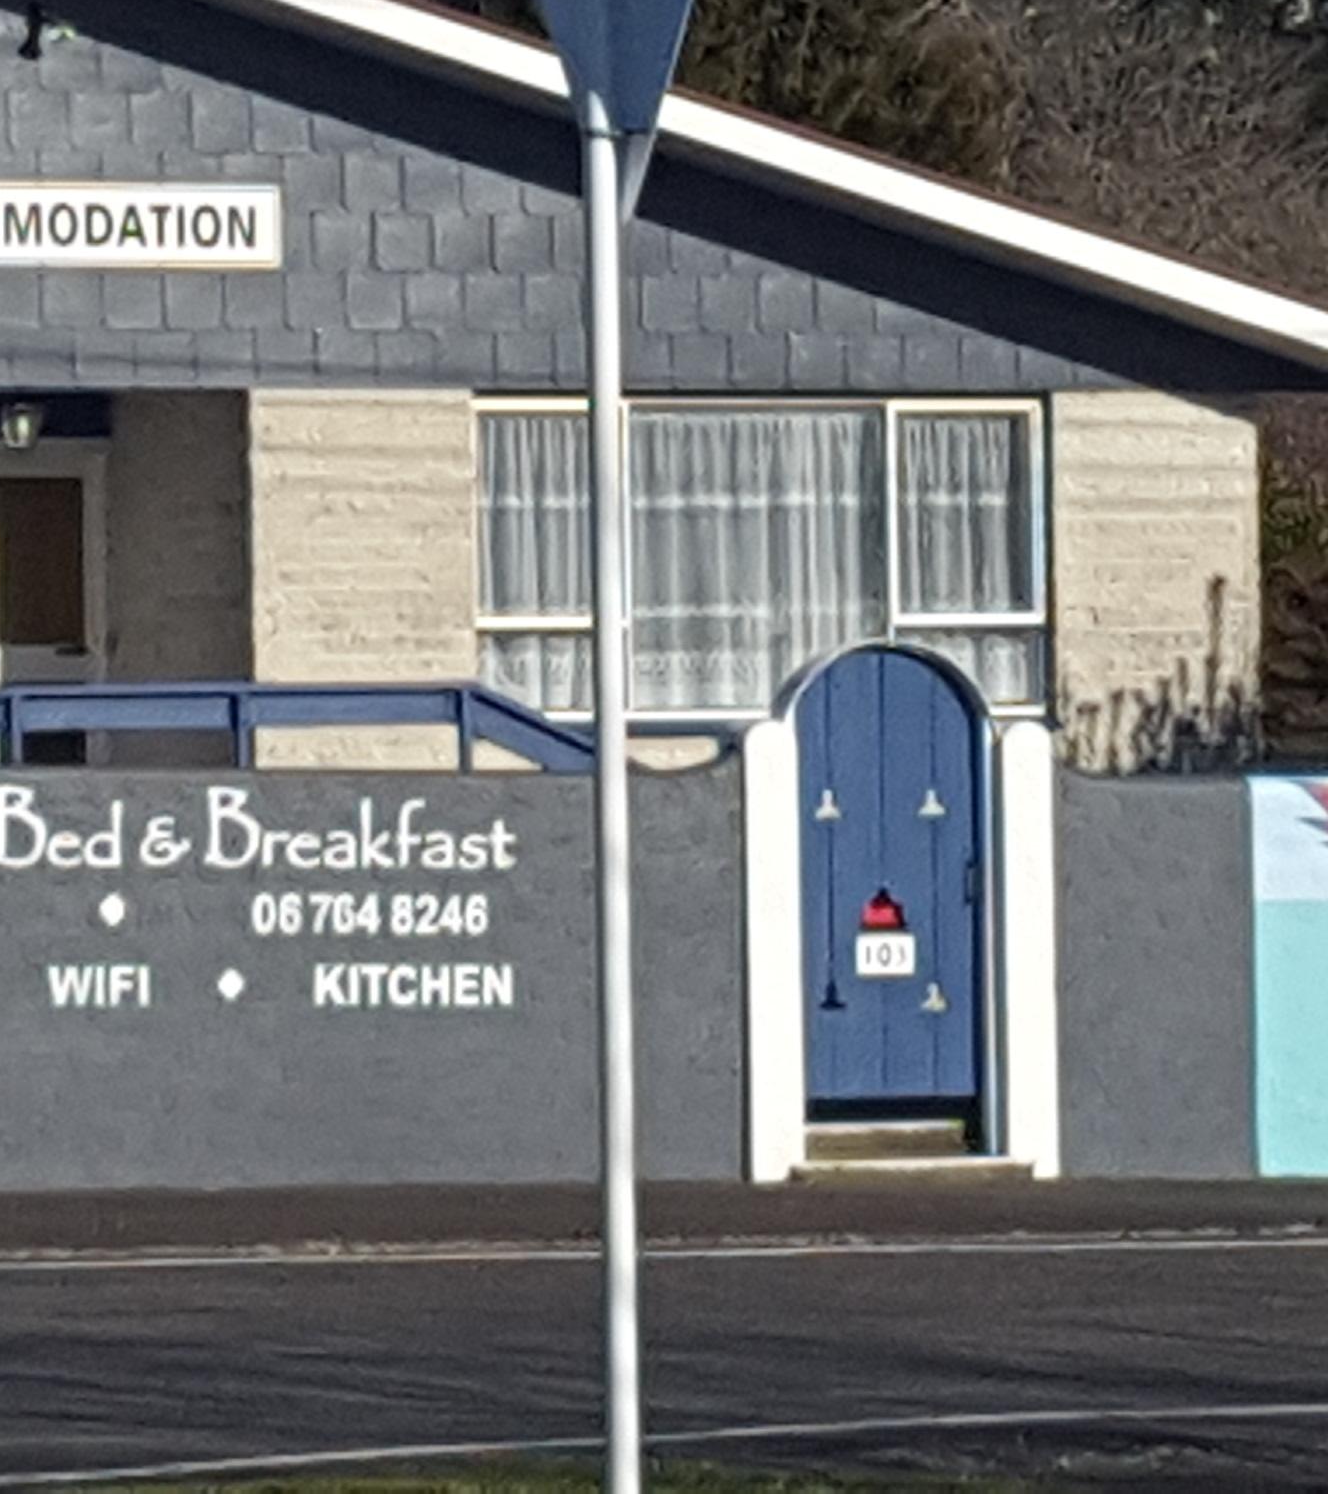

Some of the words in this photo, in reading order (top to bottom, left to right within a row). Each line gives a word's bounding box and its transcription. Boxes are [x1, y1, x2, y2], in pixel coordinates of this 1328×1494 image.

[139, 815, 191, 867] &
[204, 786, 517, 870] Breakfast
[251, 892, 303, 935] 06
[309, 892, 381, 935] 764
[389, 893, 489, 936] 8246
[48, 964, 150, 1006] WIFI
[313, 963, 514, 1006] KITCHEN
